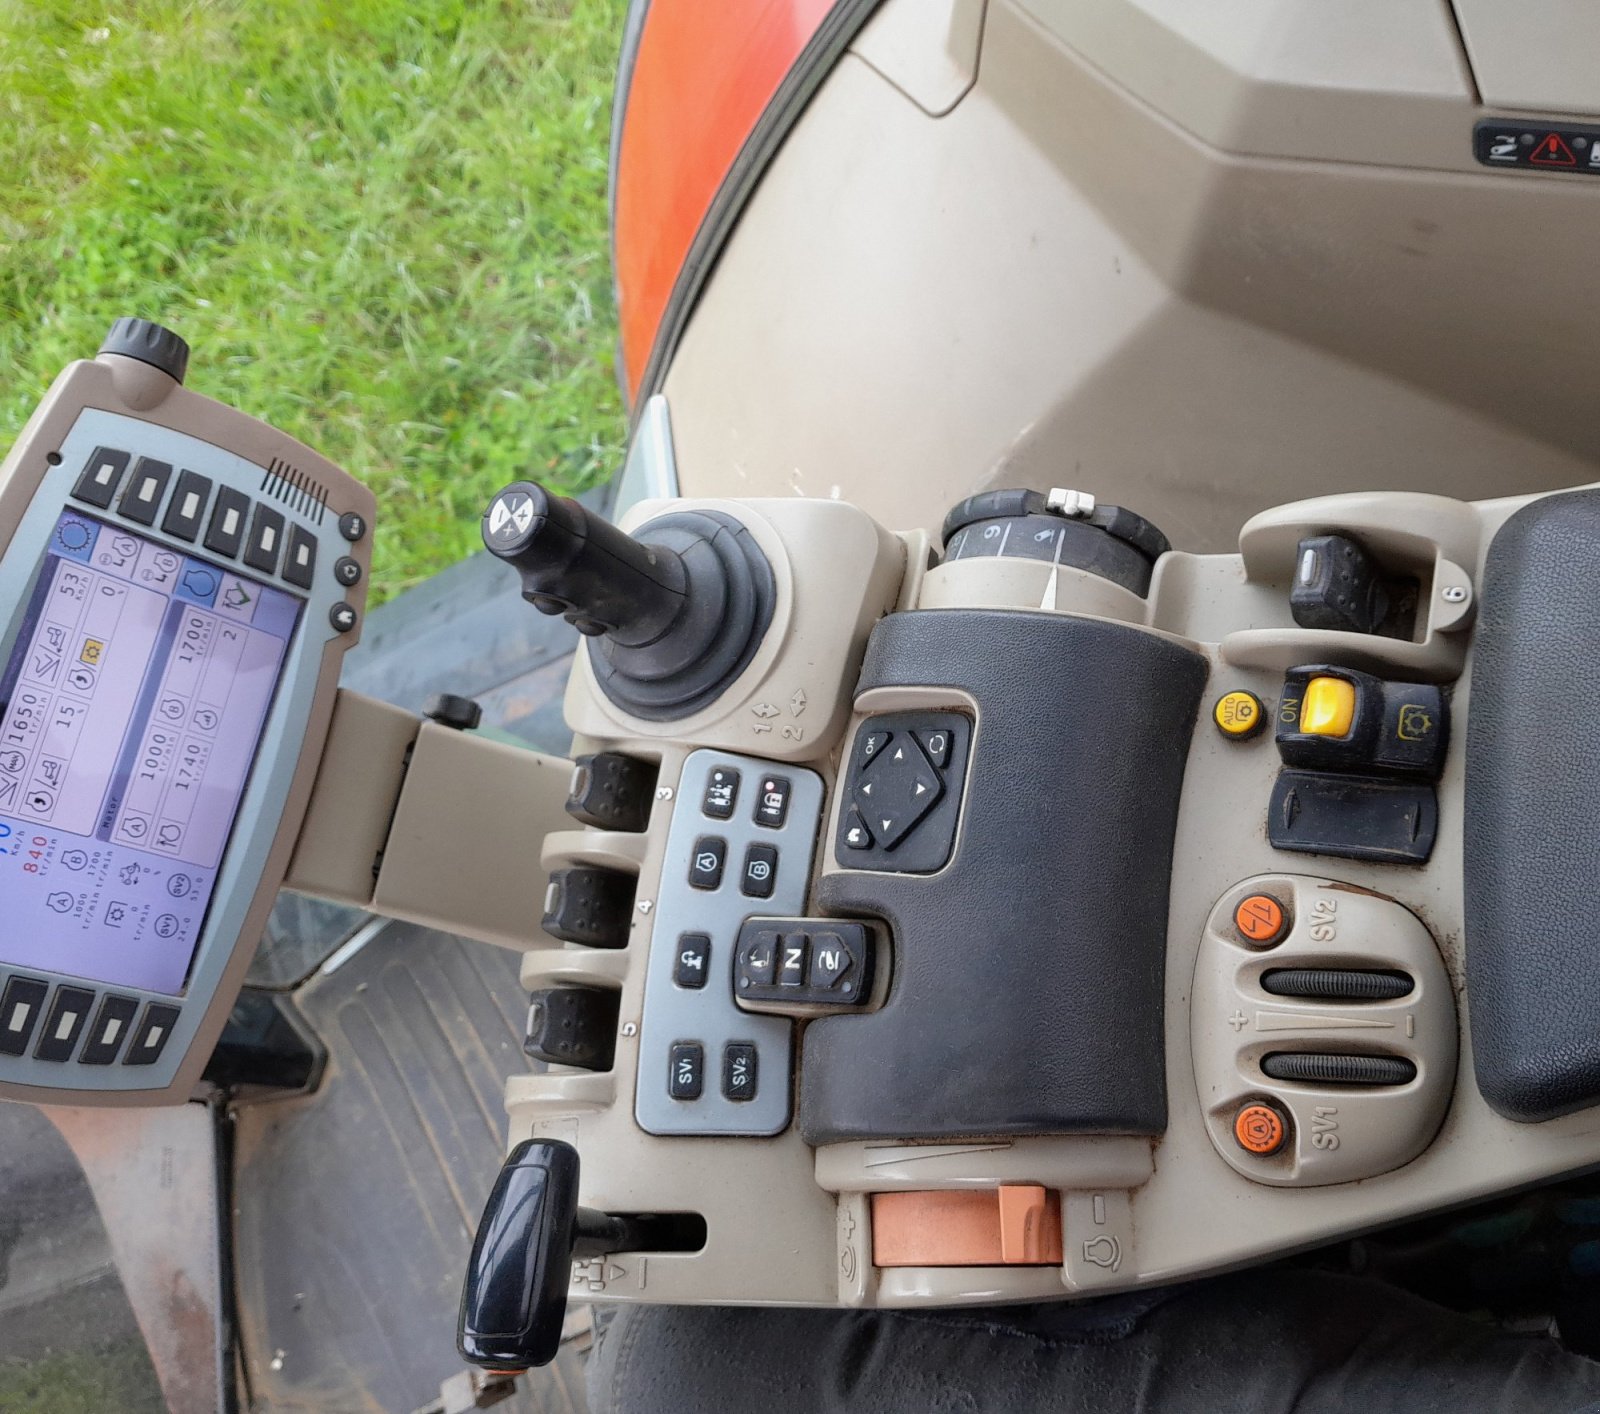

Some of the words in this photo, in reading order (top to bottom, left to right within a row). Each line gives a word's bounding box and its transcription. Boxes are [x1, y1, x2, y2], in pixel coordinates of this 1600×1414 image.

[60, 573, 79, 597] 53
[1442, 586, 1467, 602] 6
[179, 618, 204, 663] 1700
[223, 630, 237, 641] 2
[8, 694, 37, 743] 1650
[55, 706, 75, 728] 15
[1224, 697, 1236, 726] AUTO
[1280, 698, 1298, 723] ON
[141, 734, 166, 780] 1000
[865, 736, 876, 755] OK
[175, 744, 200, 790] 1740
[655, 786, 674, 802] 3
[23, 836, 47, 873] 840
[87, 851, 102, 876] 1700
[173, 876, 185, 895] SV2
[73, 893, 88, 918] 1000
[636, 899, 653, 915] 4
[160, 916, 173, 935] SV1
[1309, 899, 1337, 942] SV2
[785, 949, 801, 968] N
[620, 1021, 638, 1038] 5
[678, 1058, 693, 1084] SV1
[732, 1057, 747, 1085] SV2
[1311, 1105, 1340, 1151] SV1
